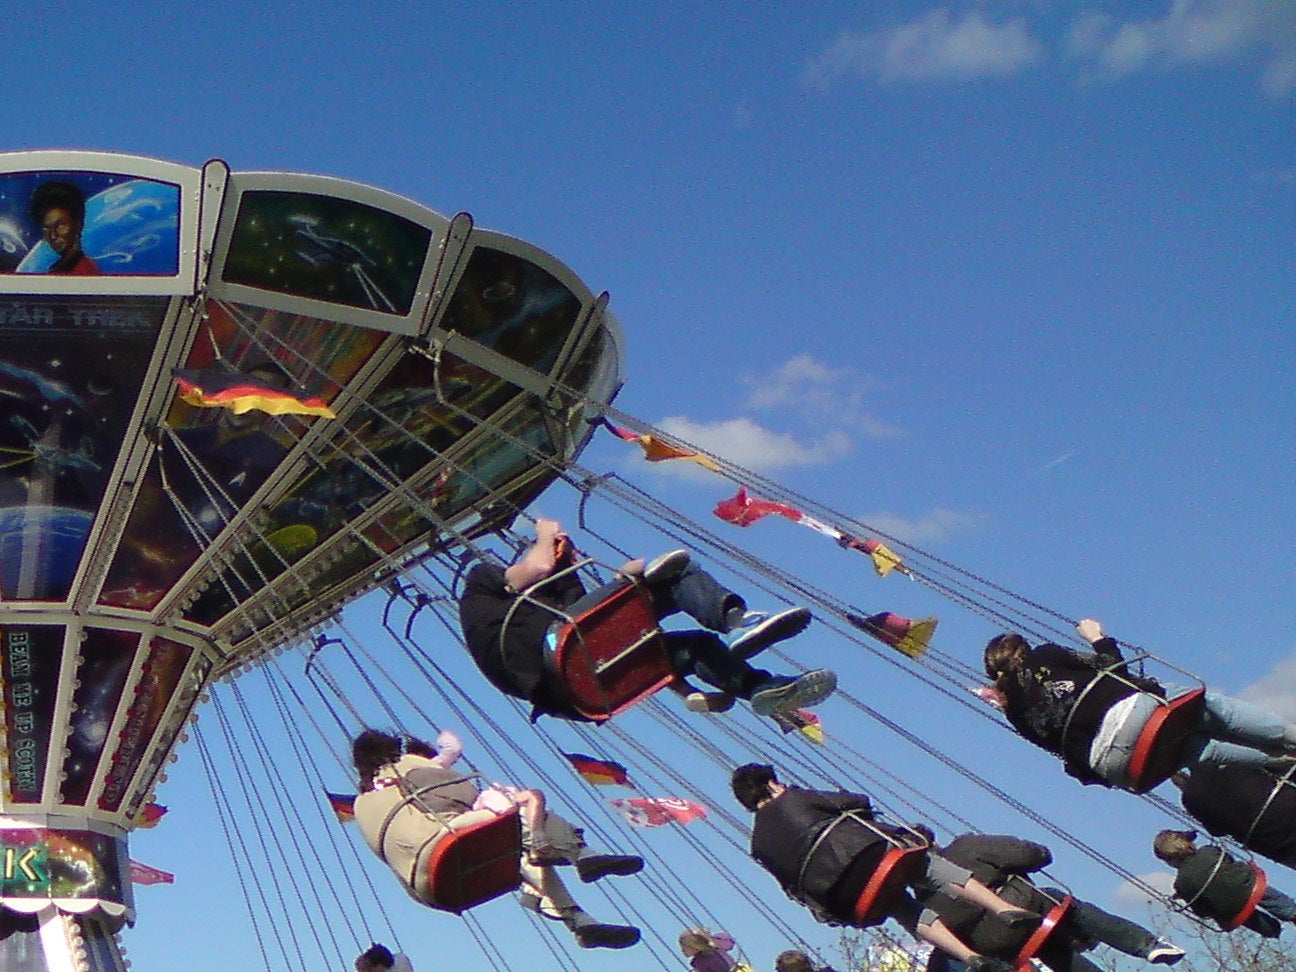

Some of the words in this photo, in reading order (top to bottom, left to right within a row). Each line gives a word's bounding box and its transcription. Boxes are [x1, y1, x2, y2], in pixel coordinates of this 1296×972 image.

[9, 632, 30, 678] BEAM
[12, 682, 32, 707] ME
[15, 711, 34, 734] UP
[16, 739, 37, 793] SCOTTY
